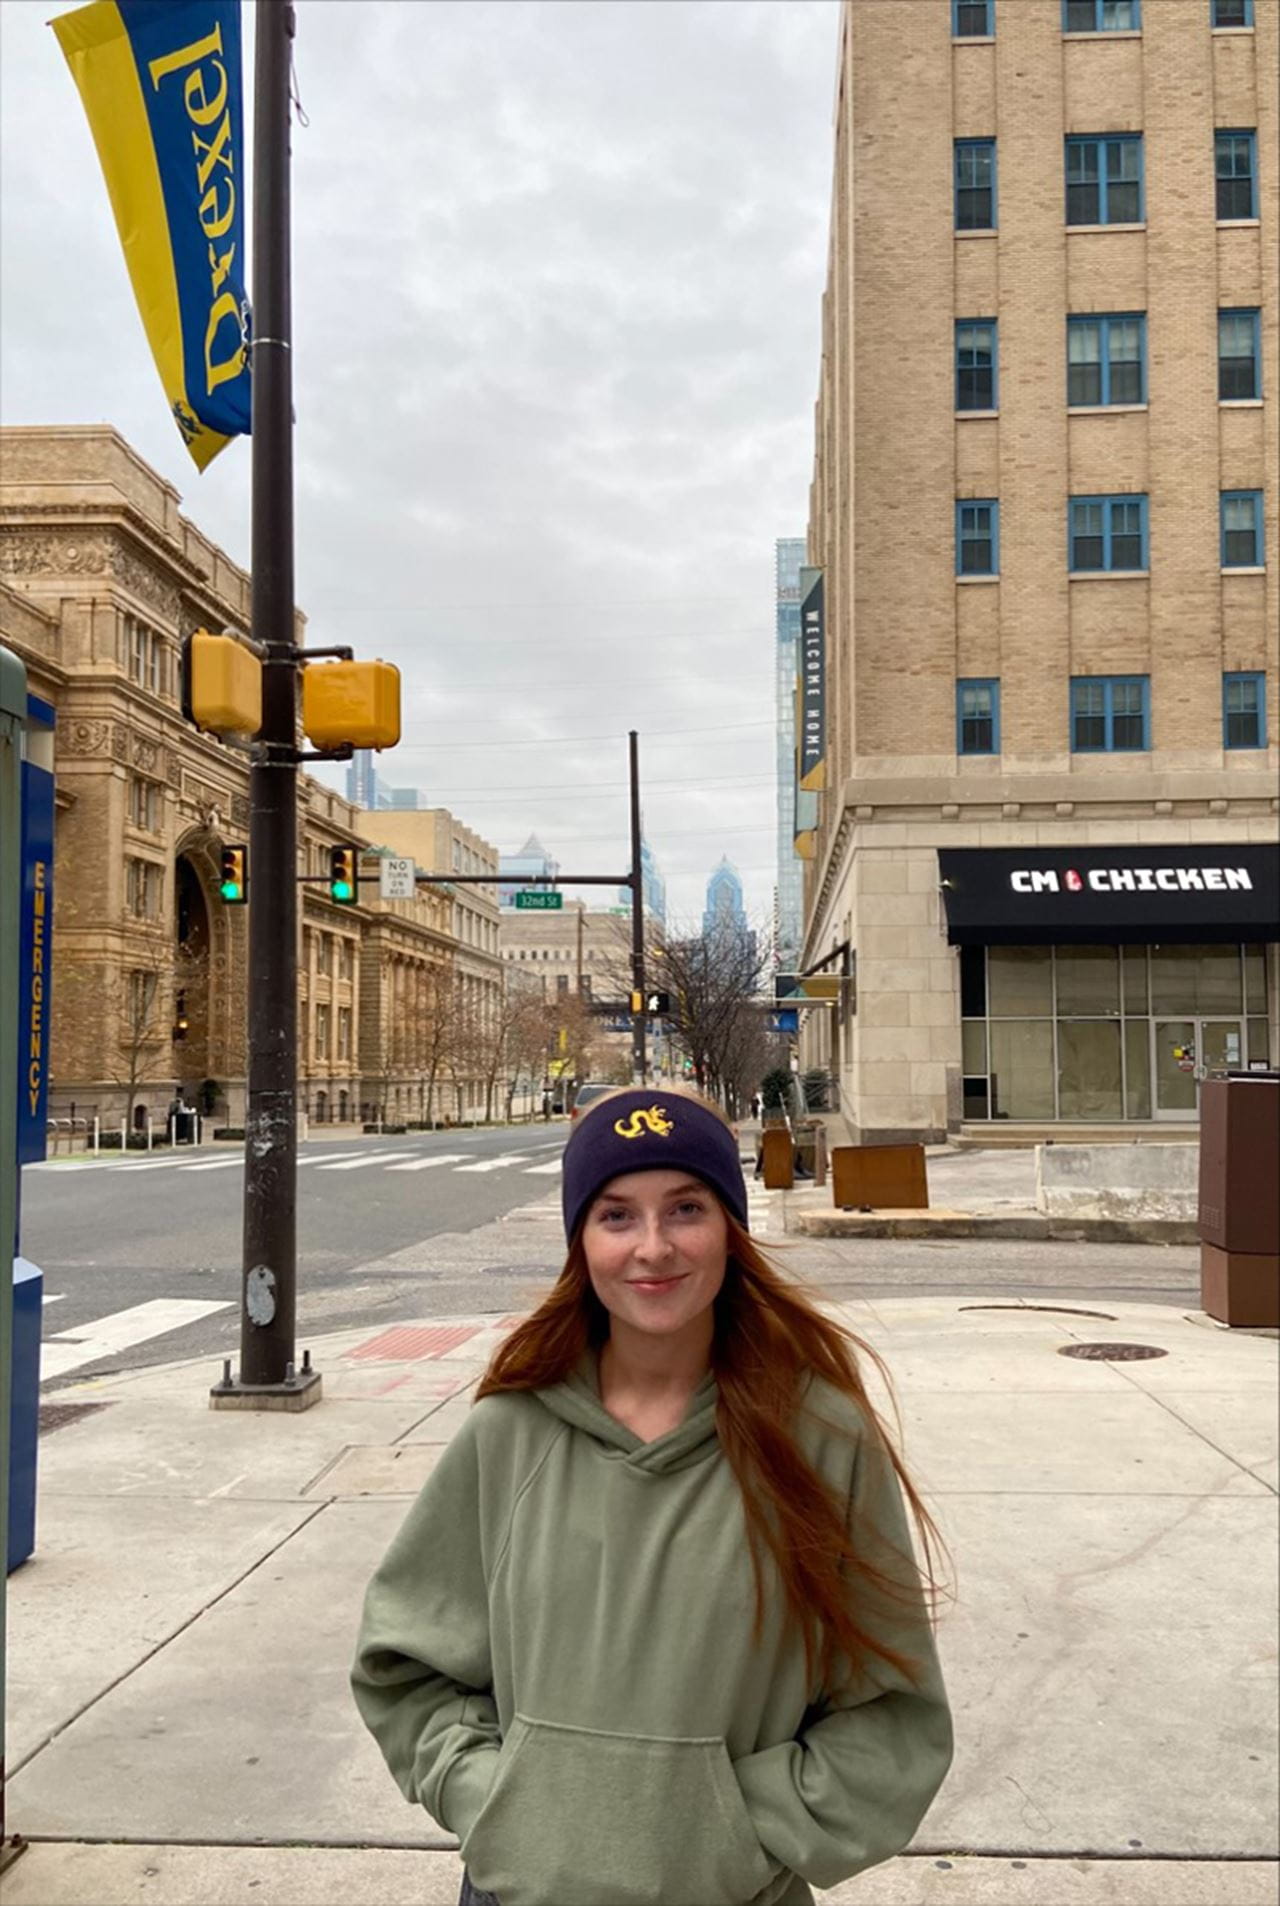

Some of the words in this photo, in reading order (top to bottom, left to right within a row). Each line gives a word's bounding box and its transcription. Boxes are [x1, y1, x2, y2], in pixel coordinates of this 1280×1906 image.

[148, 21, 247, 396] Drexel
[805, 610, 821, 696] WELCOME
[805, 709, 821, 755] HOME
[388, 861, 407, 870] NO
[1010, 870, 1060, 892] CM
[1088, 868, 1253, 891] CHICKEN
[520, 895, 545, 906] 32nd
[547, 895, 557, 906] St
[29, 861, 45, 1117] EMERGENCY
